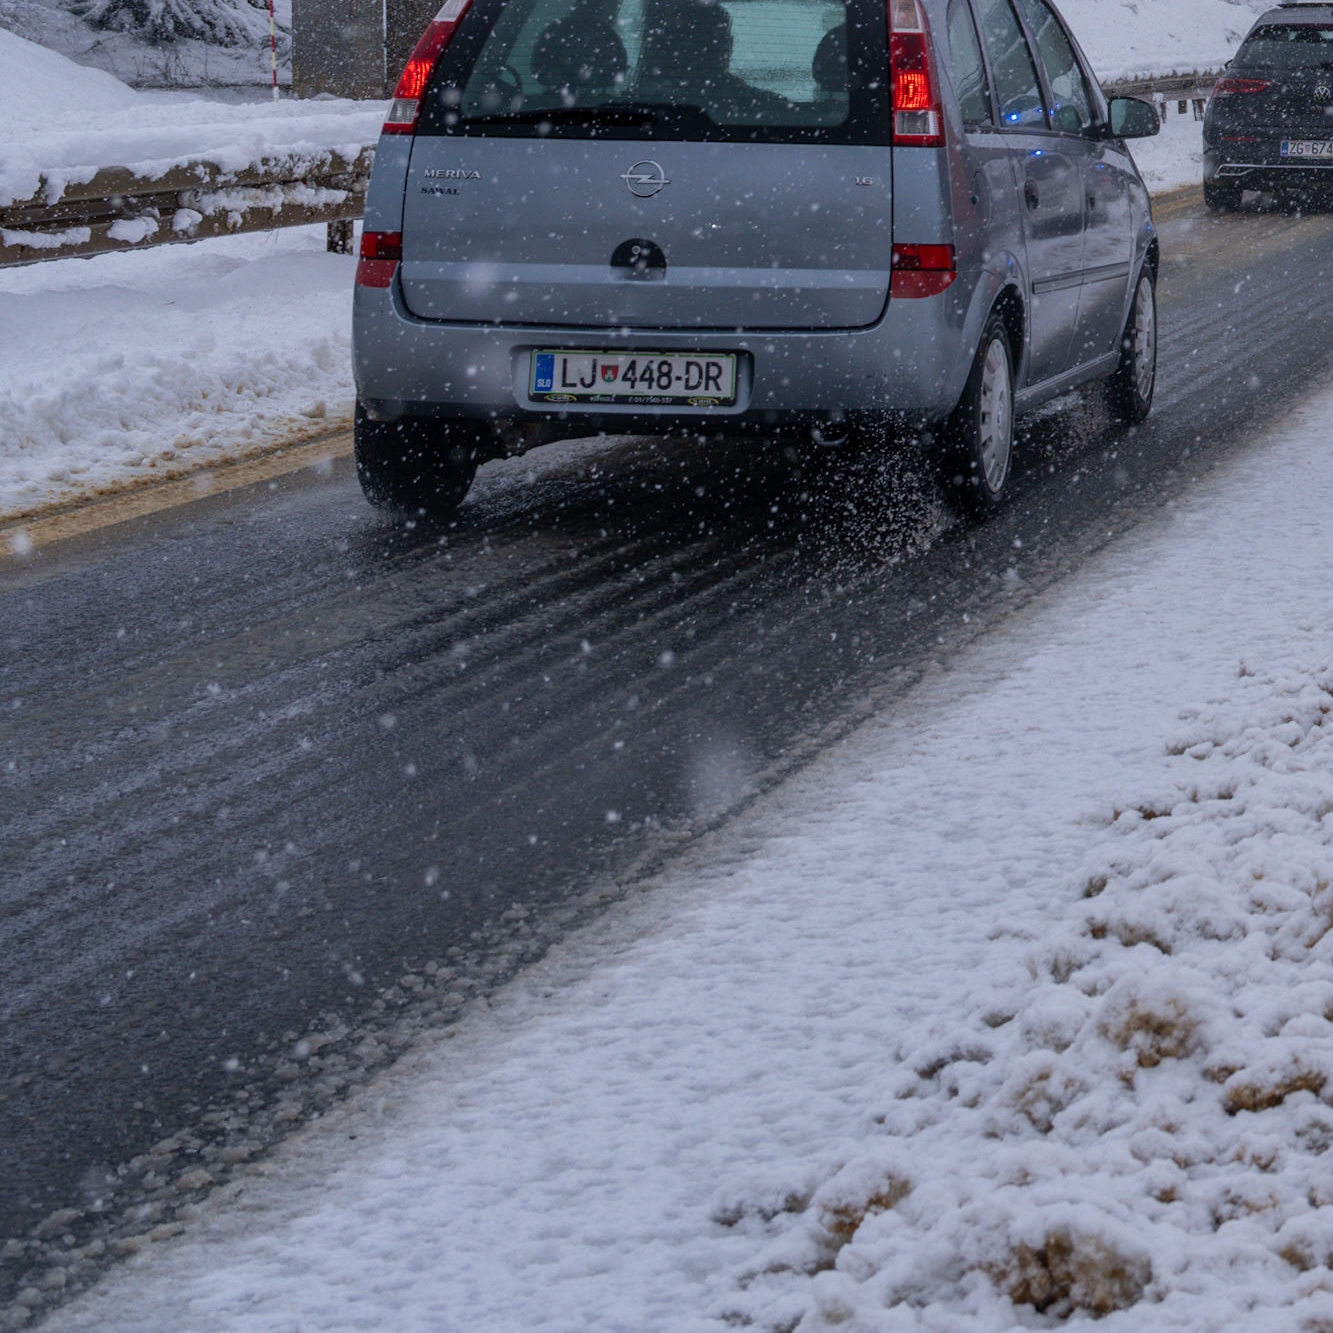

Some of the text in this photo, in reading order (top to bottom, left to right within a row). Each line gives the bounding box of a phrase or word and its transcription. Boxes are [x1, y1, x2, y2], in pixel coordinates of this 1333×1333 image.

[1289, 142, 1304, 155] ZG
[424, 169, 482, 179] MERIVA
[855, 176, 874, 186] 1.6
[421, 187, 460, 195] SAWAL
[537, 358, 723, 392] SLO LJ 448-DR
